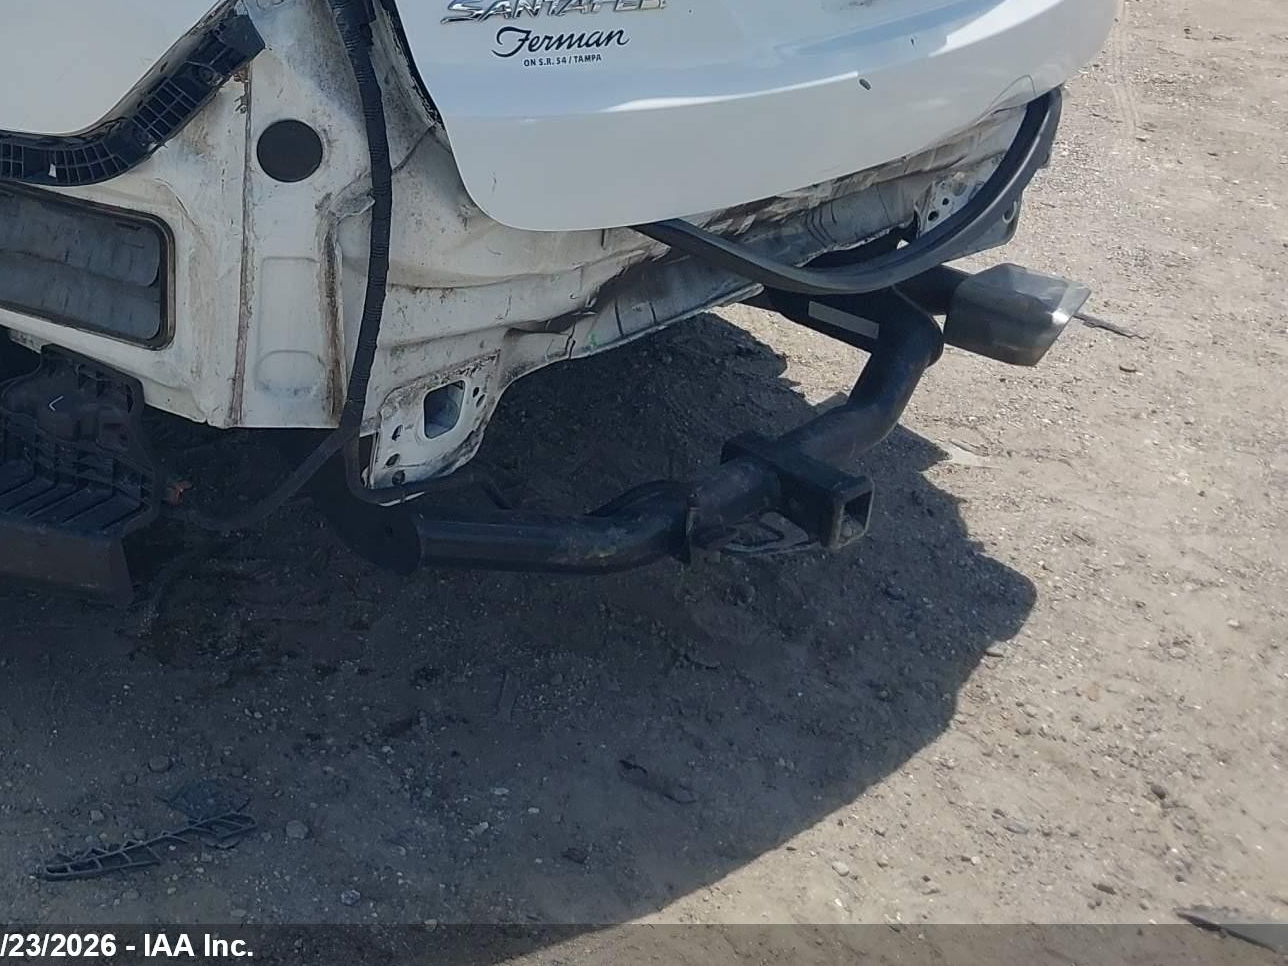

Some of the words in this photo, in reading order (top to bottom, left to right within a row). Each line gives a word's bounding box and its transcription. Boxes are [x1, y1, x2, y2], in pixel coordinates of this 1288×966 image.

[491, 26, 630, 57] Ferman
[523, 58, 536, 67] ON
[538, 57, 554, 66] S.R.
[556, 56, 567, 65] 54
[573, 54, 602, 64] TAMPA
